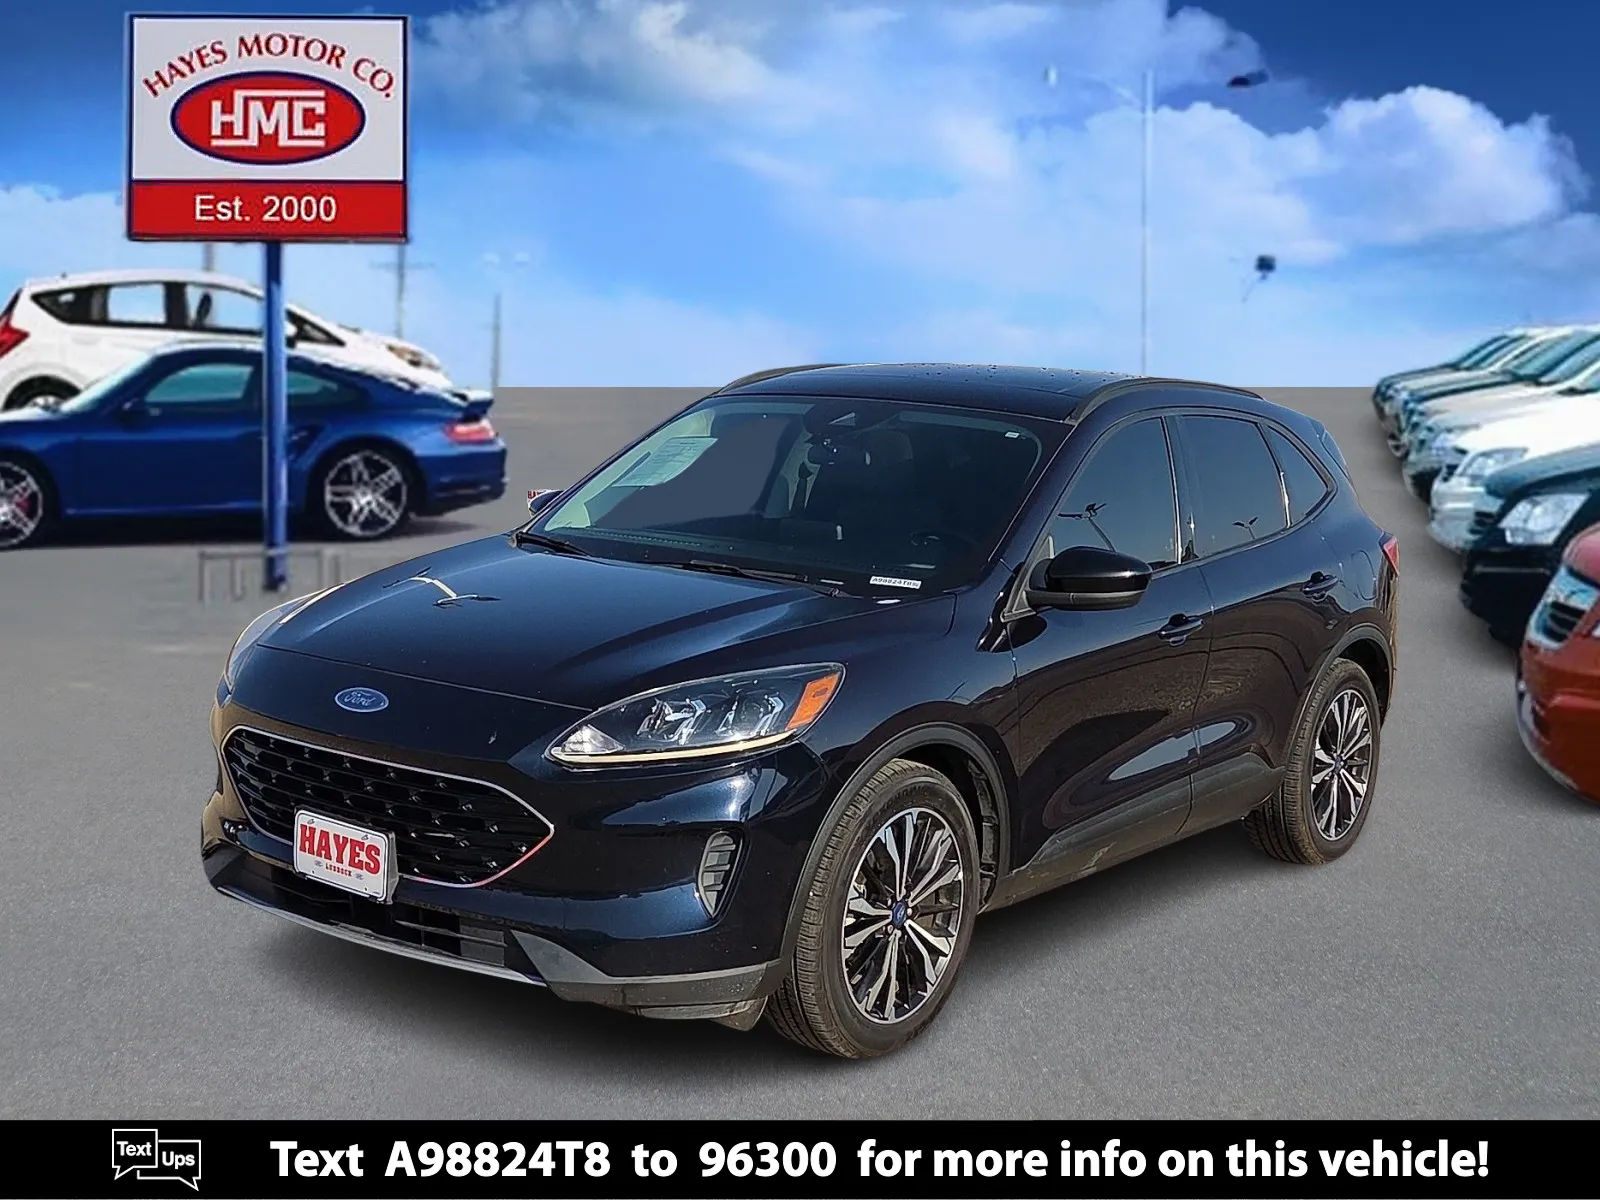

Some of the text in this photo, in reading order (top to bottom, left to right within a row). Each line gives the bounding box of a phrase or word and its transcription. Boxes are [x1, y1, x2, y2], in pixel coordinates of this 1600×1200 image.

[142, 33, 395, 98] HAYES MOTOR CO.
[210, 89, 326, 147] HMC
[194, 195, 337, 222] Est. 2000
[299, 824, 381, 875] HAYES
